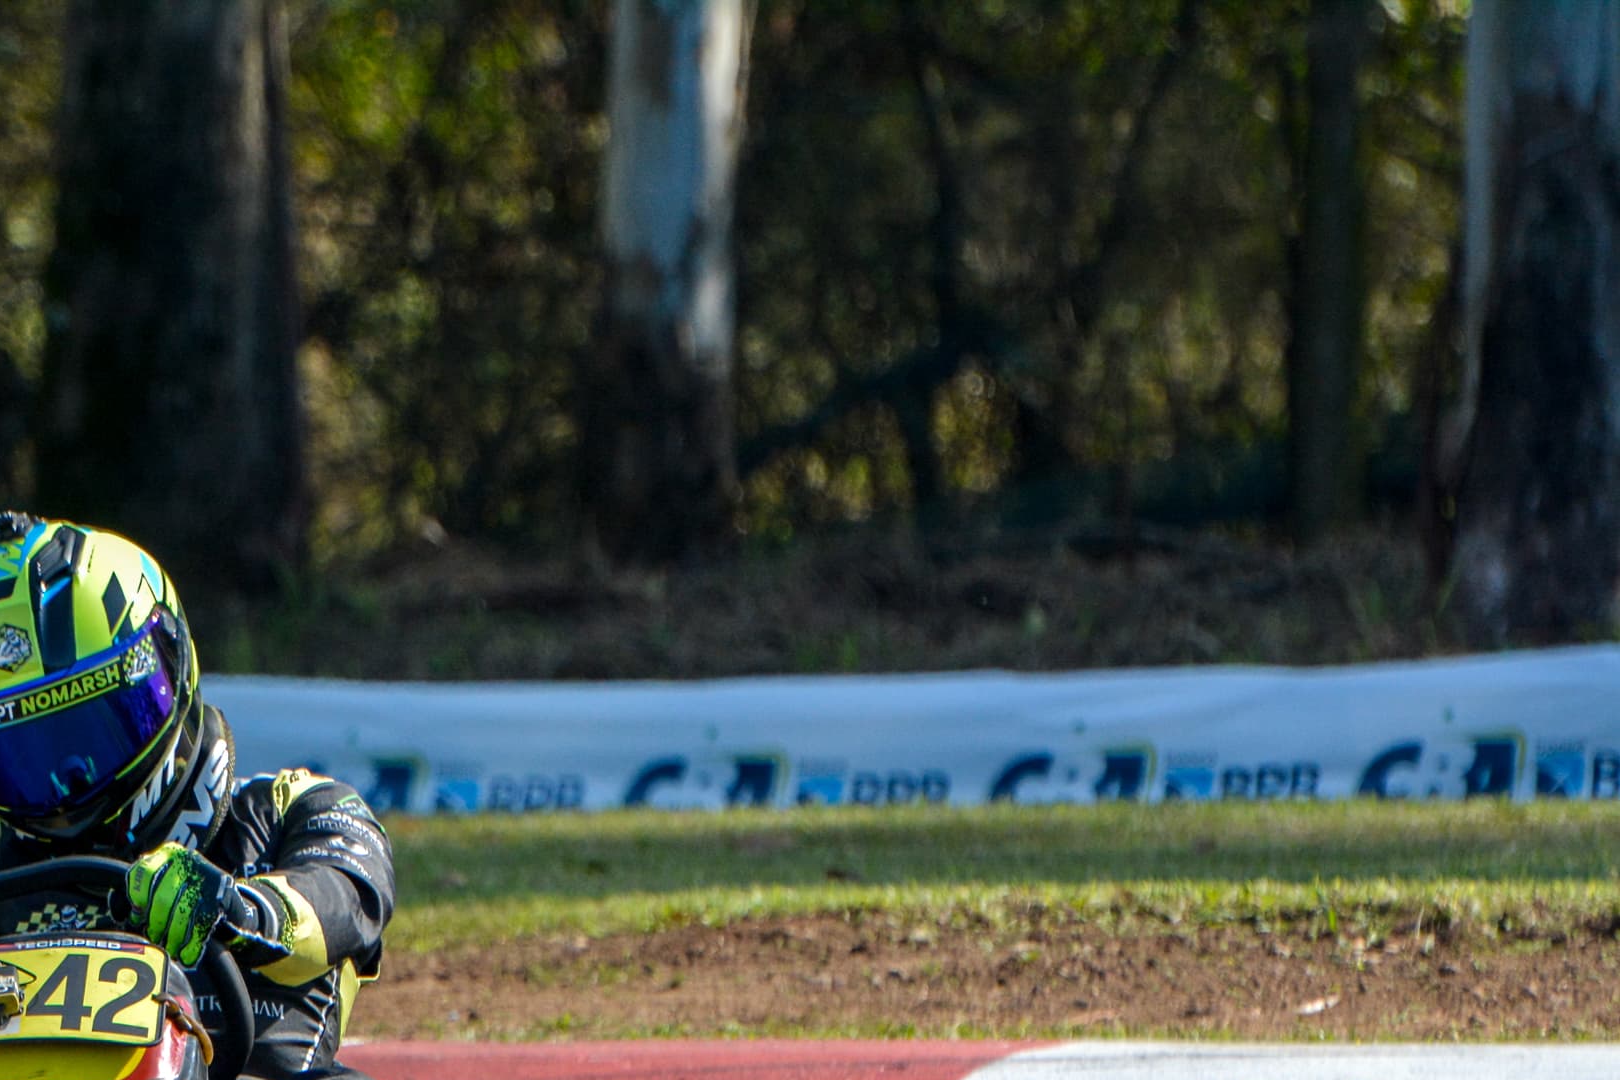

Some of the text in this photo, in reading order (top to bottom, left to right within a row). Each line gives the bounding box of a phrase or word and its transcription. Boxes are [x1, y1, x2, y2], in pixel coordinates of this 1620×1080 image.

[20, 664, 121, 717] NOMARSH
[14, 937, 122, 950] TECHSPEED
[25, 953, 157, 1038] 42
